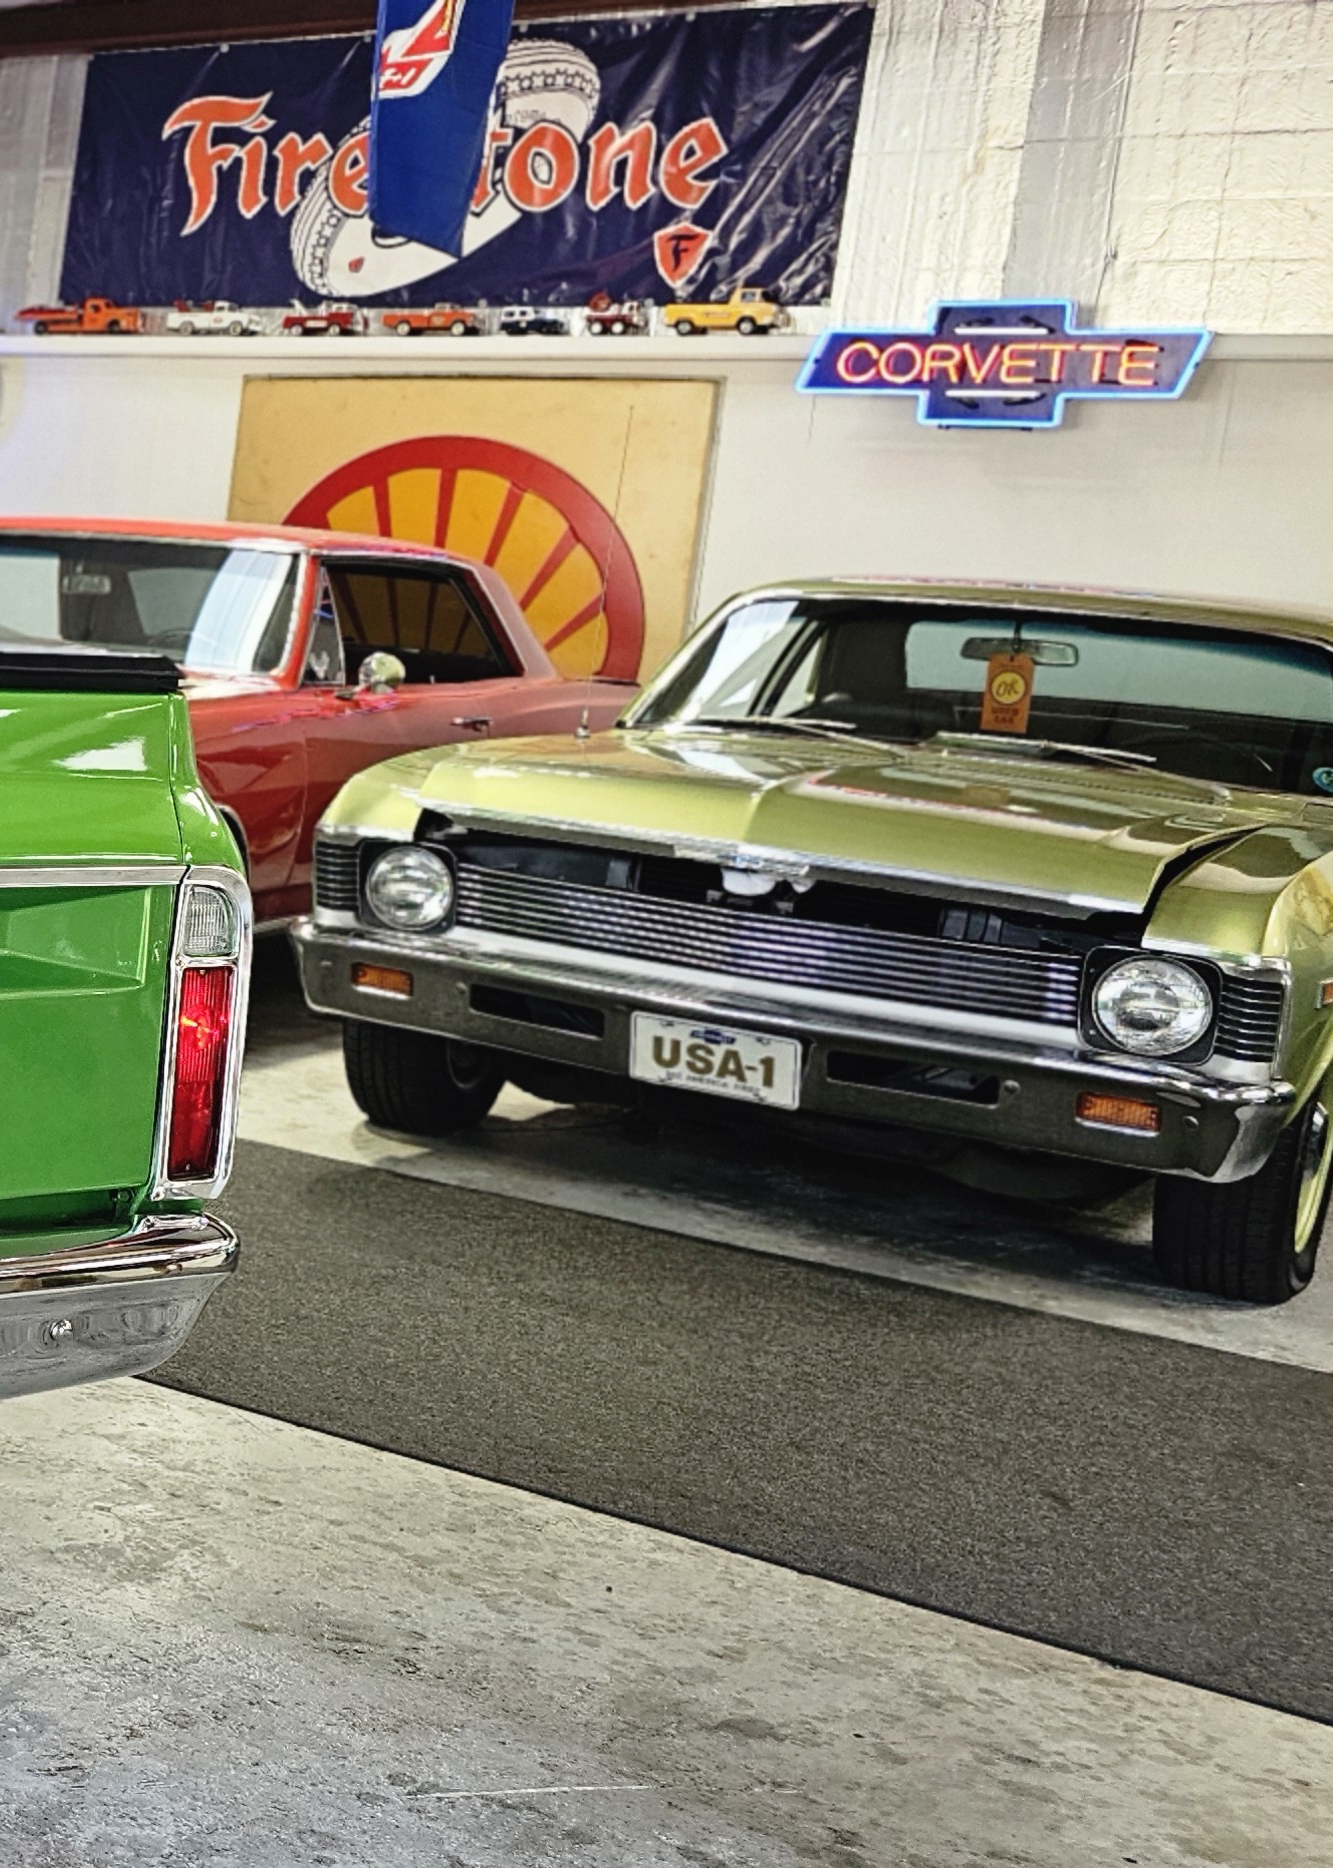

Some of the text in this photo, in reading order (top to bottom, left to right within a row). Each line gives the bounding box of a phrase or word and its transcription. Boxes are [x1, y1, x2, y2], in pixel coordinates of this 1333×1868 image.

[161, 91, 729, 236] Firetone
[666, 234, 701, 272] F
[836, 340, 1163, 387] CORVETTE
[996, 678, 1020, 697] OK
[652, 1035, 775, 1088] USA-1
